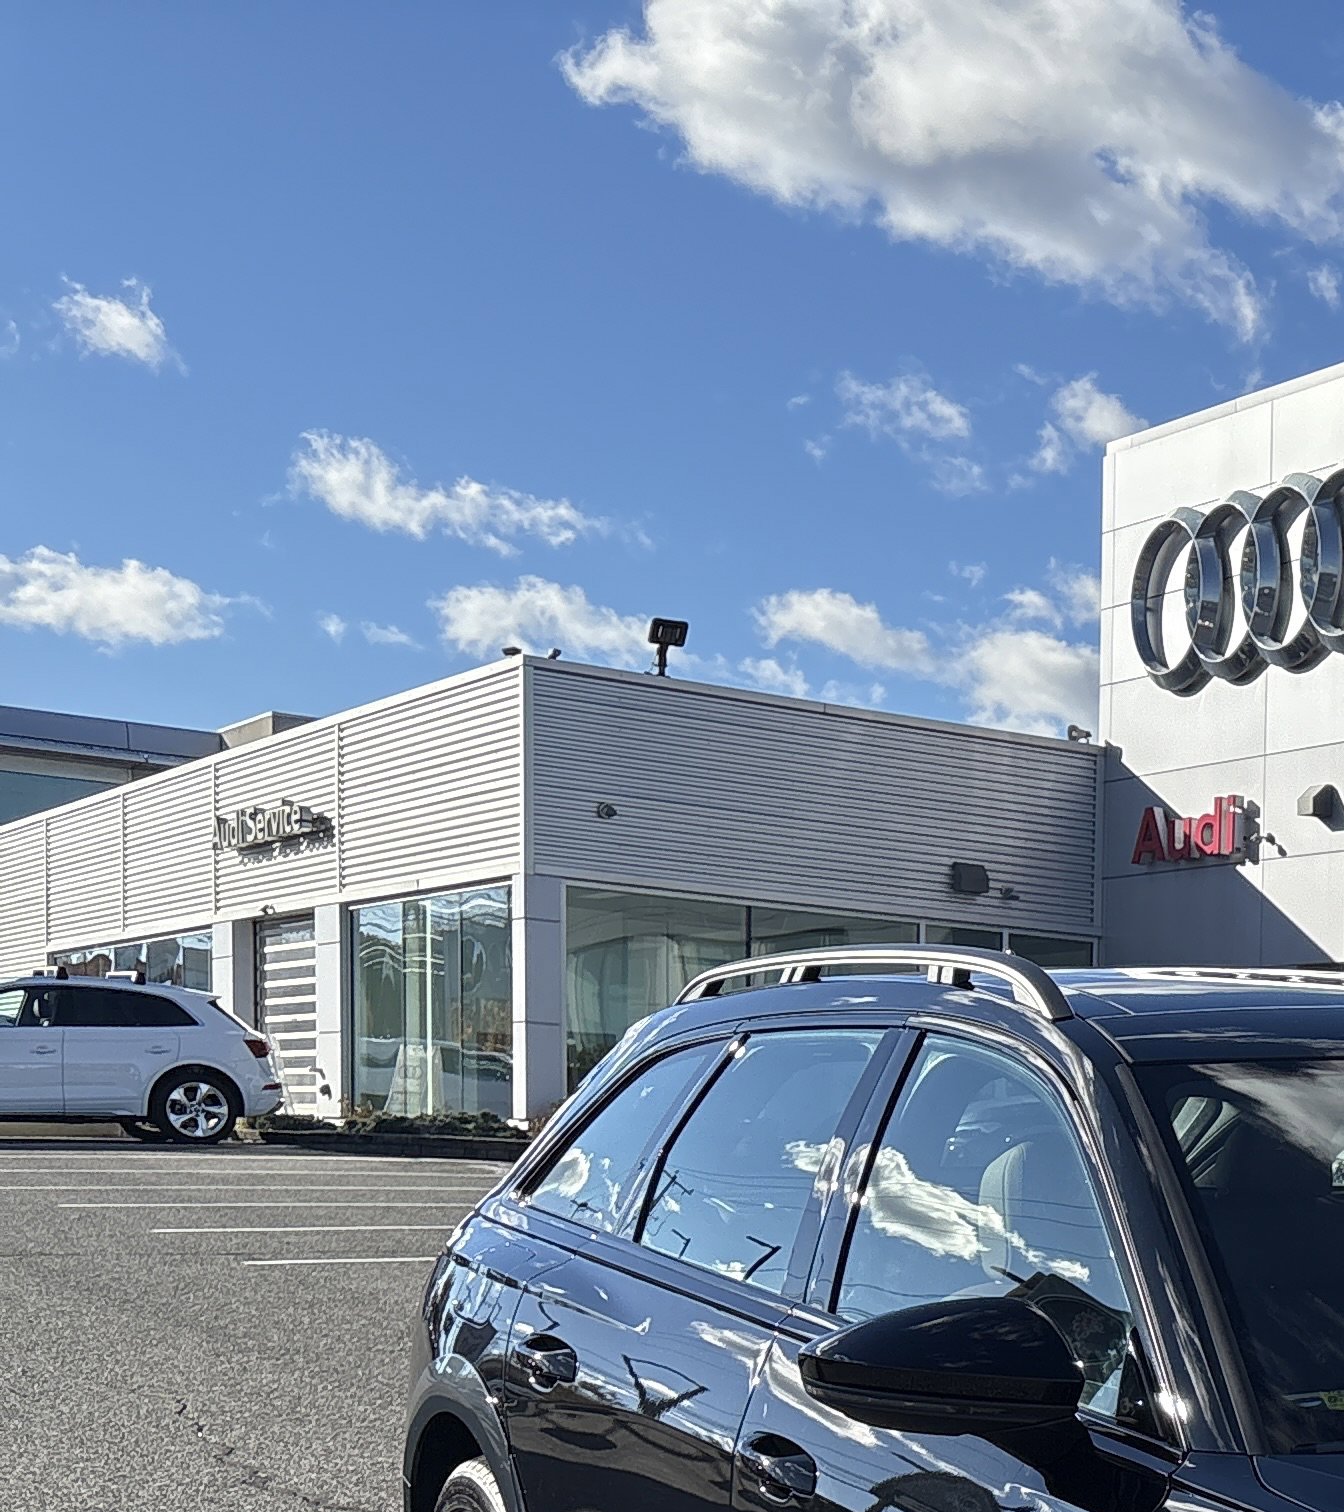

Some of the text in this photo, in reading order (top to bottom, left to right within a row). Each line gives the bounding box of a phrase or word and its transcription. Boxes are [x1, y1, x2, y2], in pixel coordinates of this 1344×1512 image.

[212, 801, 302, 850] Audi Service
[1131, 794, 1241, 865] Audi
